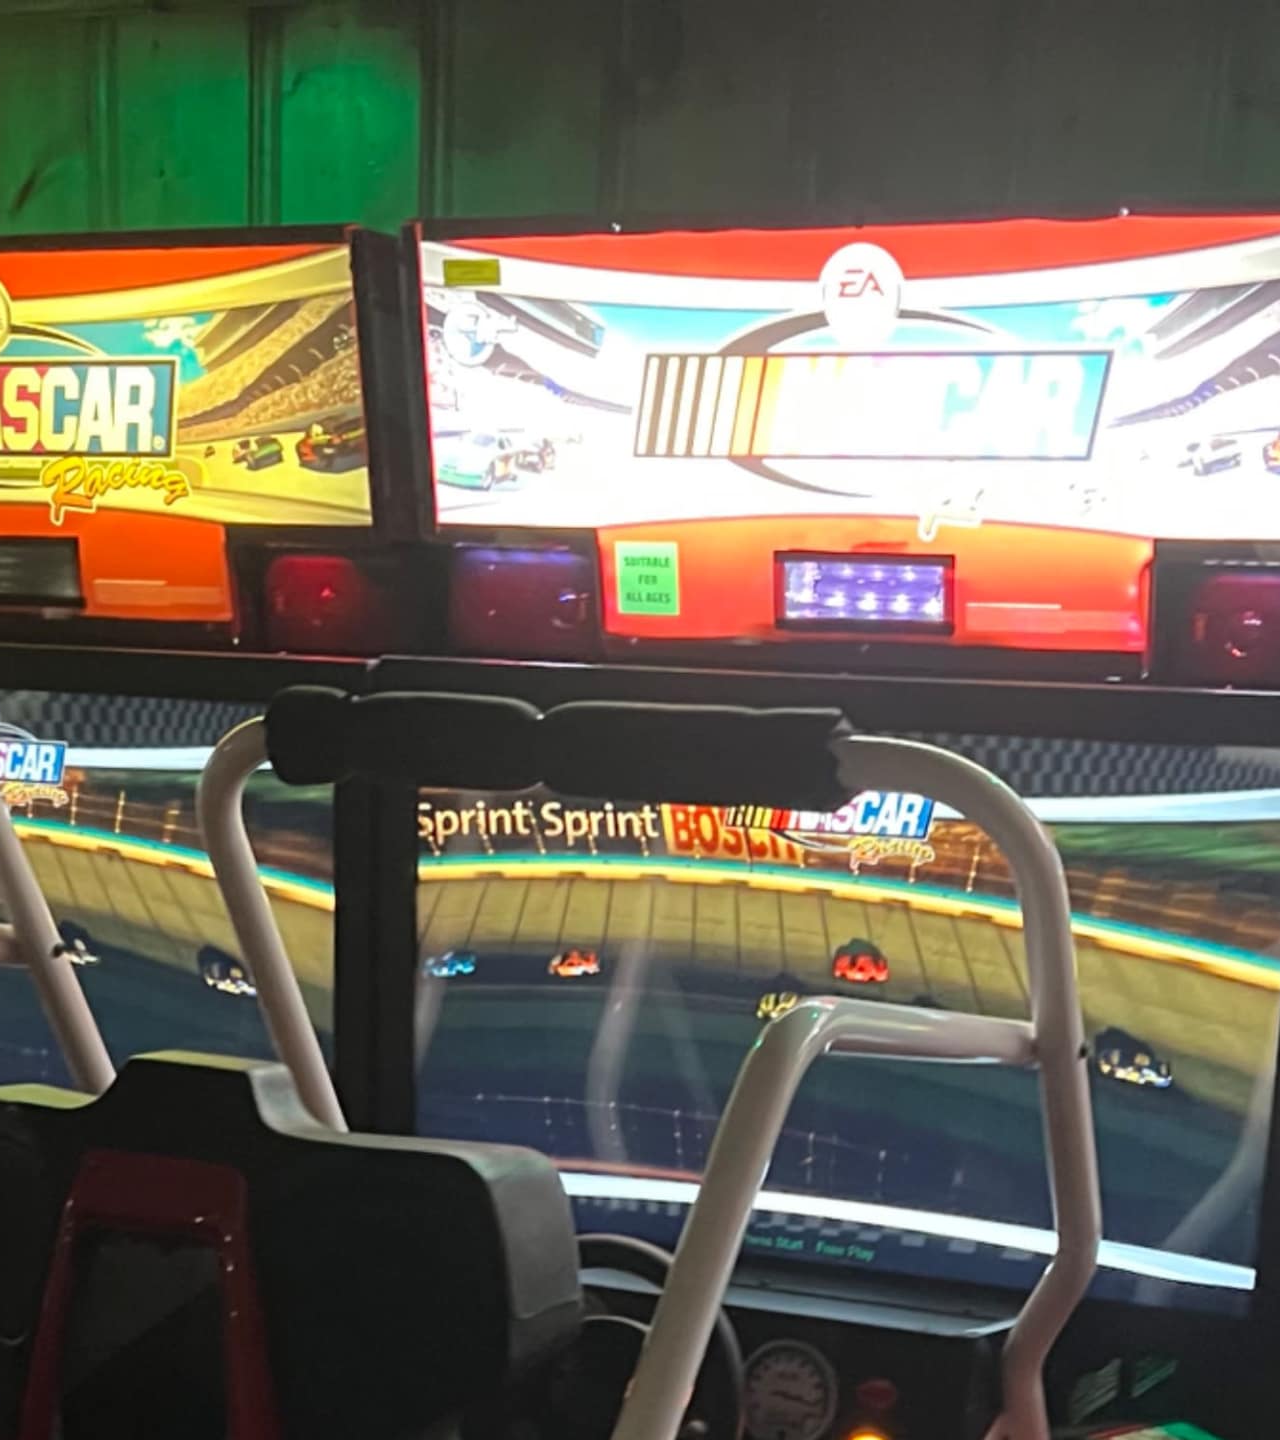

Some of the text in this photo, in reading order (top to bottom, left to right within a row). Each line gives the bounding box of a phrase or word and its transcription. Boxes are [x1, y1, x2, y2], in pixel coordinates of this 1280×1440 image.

[837, 269, 885, 298] EA
[41, 456, 190, 524] Racing
[418, 802, 531, 842] Sprint
[541, 802, 660, 847] Sprint
